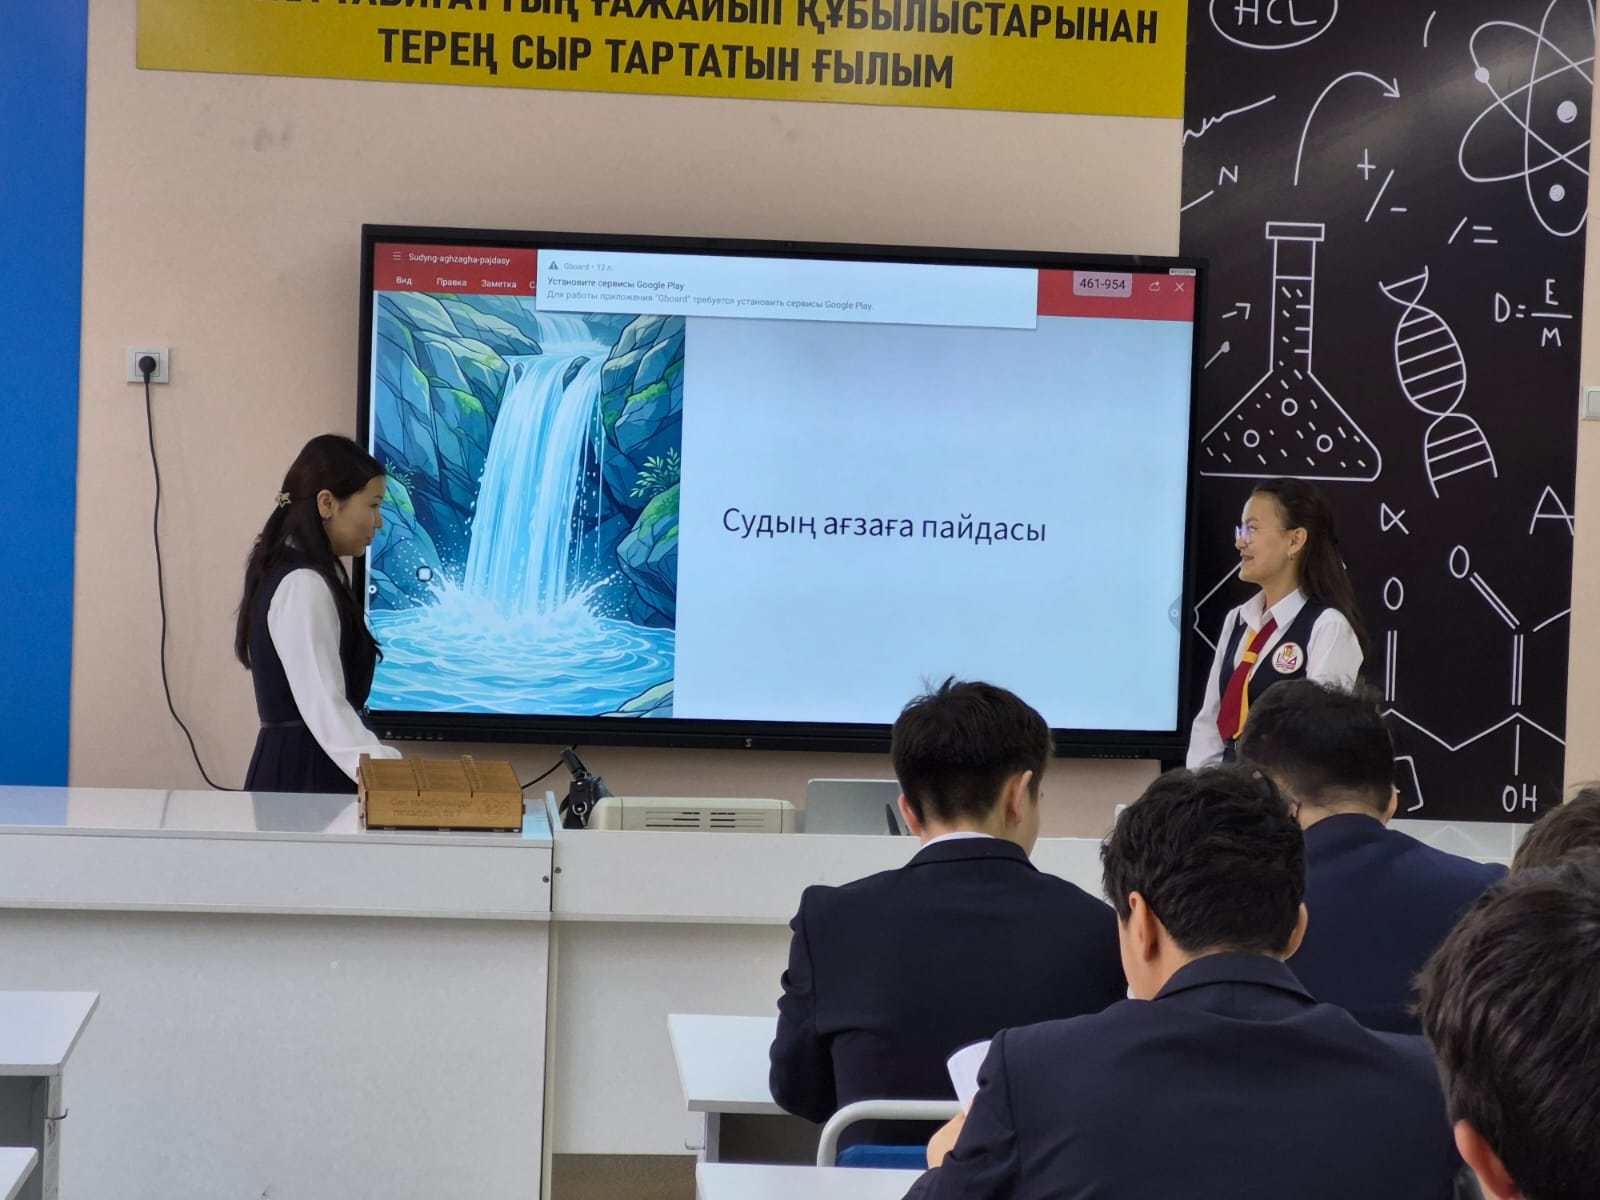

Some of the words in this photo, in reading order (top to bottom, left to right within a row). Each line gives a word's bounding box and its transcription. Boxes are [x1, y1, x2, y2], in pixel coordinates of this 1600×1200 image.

[377, 28, 498, 75] ТЕРЕҢ
[512, 34, 592, 71] СЫР
[605, 39, 800, 82] ТАРТАТЫН
[811, 49, 954, 89] ҒЫЛЫМ
[1218, 165, 1239, 186] N
[408, 252, 511, 267] Sudyng-aghzagha-pajdasy
[563, 262, 590, 271] Gboard
[396, 276, 413, 286] Вид
[436, 277, 468, 287] Правка
[481, 279, 517, 289] Заметка
[547, 277, 596, 287] Установите
[597, 280, 635, 290] сервисы
[636, 281, 666, 291] Google
[667, 282, 685, 291] Play
[1079, 278, 1126, 290] 461-954
[1545, 278, 1559, 306] E
[546, 290, 564, 299] Для
[565, 290, 598, 301] работы
[600, 292, 653, 303] приложения
[693, 296, 735, 305] требуется
[736, 298, 785, 307] установить
[786, 299, 823, 309] сервисы
[825, 300, 854, 310] Google
[1541, 327, 1562, 347] M
[722, 507, 816, 540] Судың
[823, 515, 913, 538] ағзаға
[922, 513, 1046, 545] пайдасы
[1502, 784, 1537, 813] OH
